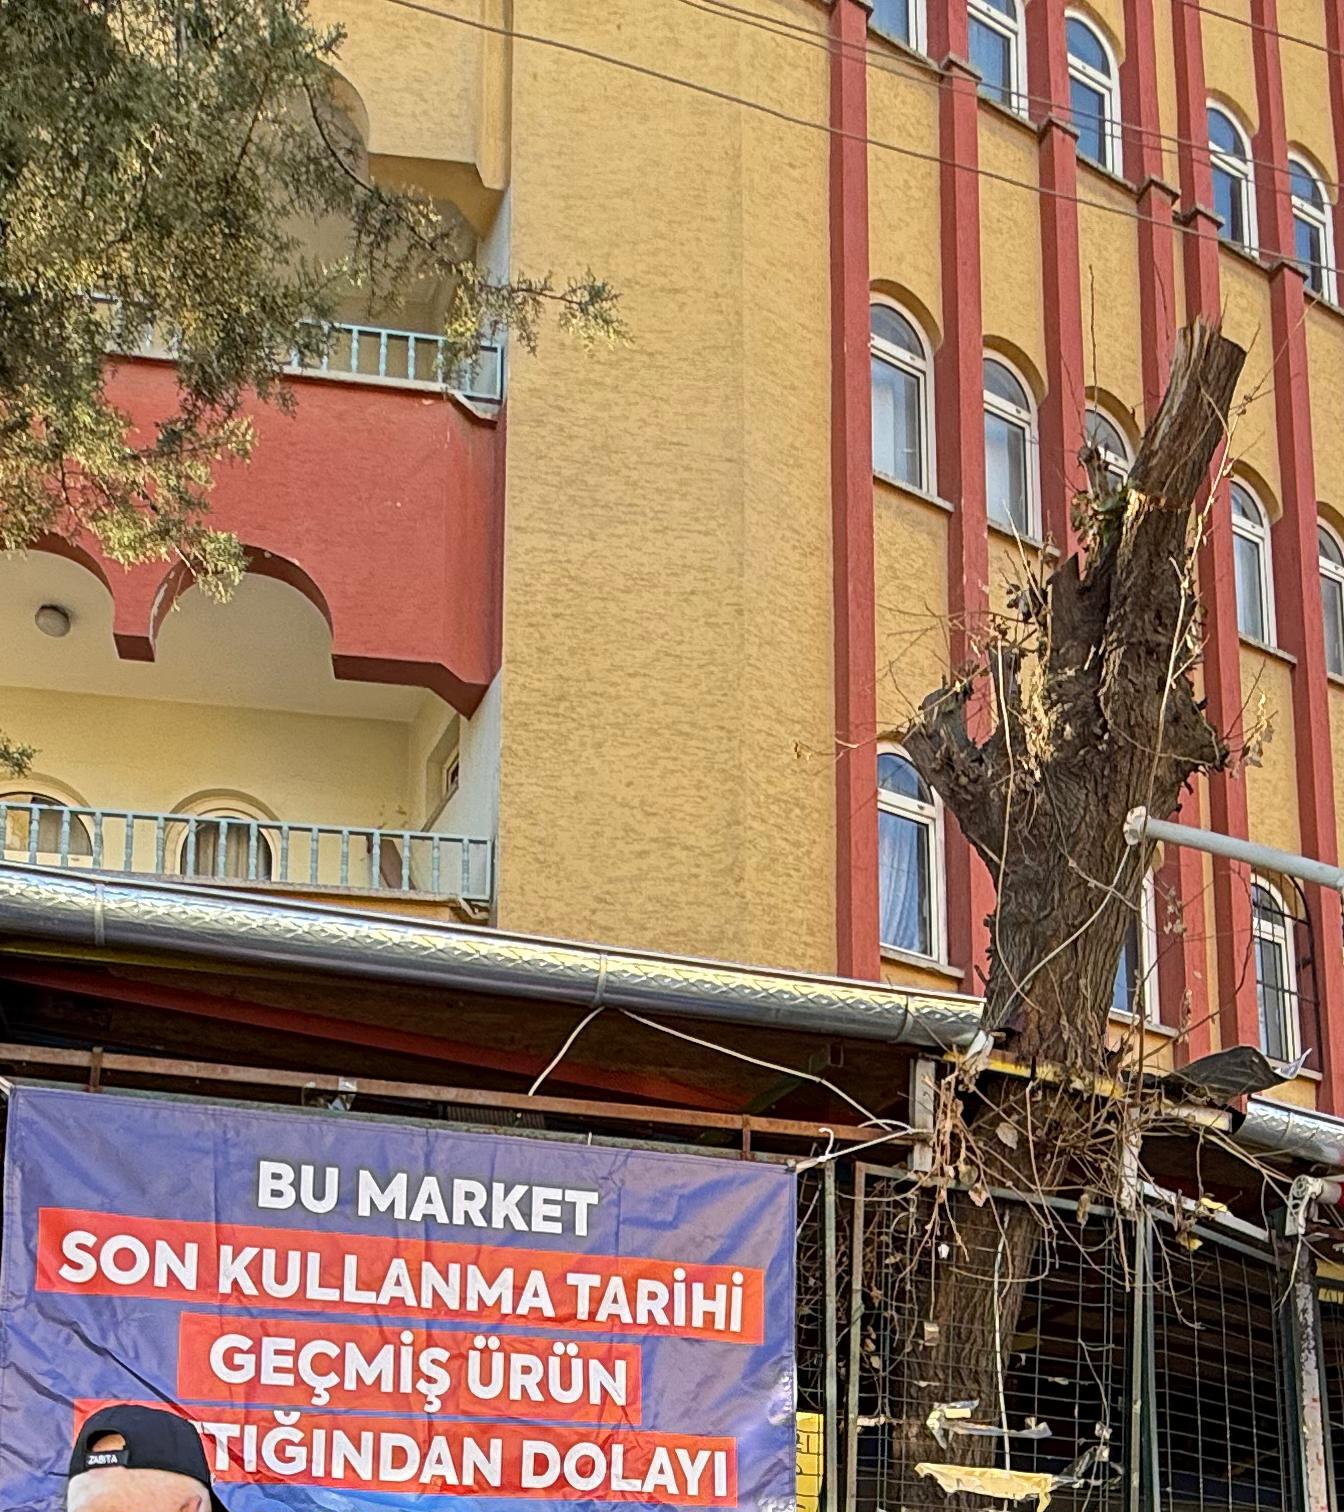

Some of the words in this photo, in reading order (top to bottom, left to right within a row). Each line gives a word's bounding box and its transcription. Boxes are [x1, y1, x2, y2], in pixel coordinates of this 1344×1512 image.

[258, 1160, 340, 1214] BU
[357, 1169, 599, 1237] MARKET
[58, 1230, 199, 1292] SON
[218, 1244, 556, 1318] KULLANMA
[566, 1267, 744, 1333] TARİHİ
[209, 1329, 452, 1414] GEÇMİŞ
[467, 1334, 627, 1407] ÜRÜN
[87, 1454, 118, 1465] ZABITA
[190, 1409, 503, 1488] TIĞINDAN
[521, 1439, 727, 1497] DOLAYI
